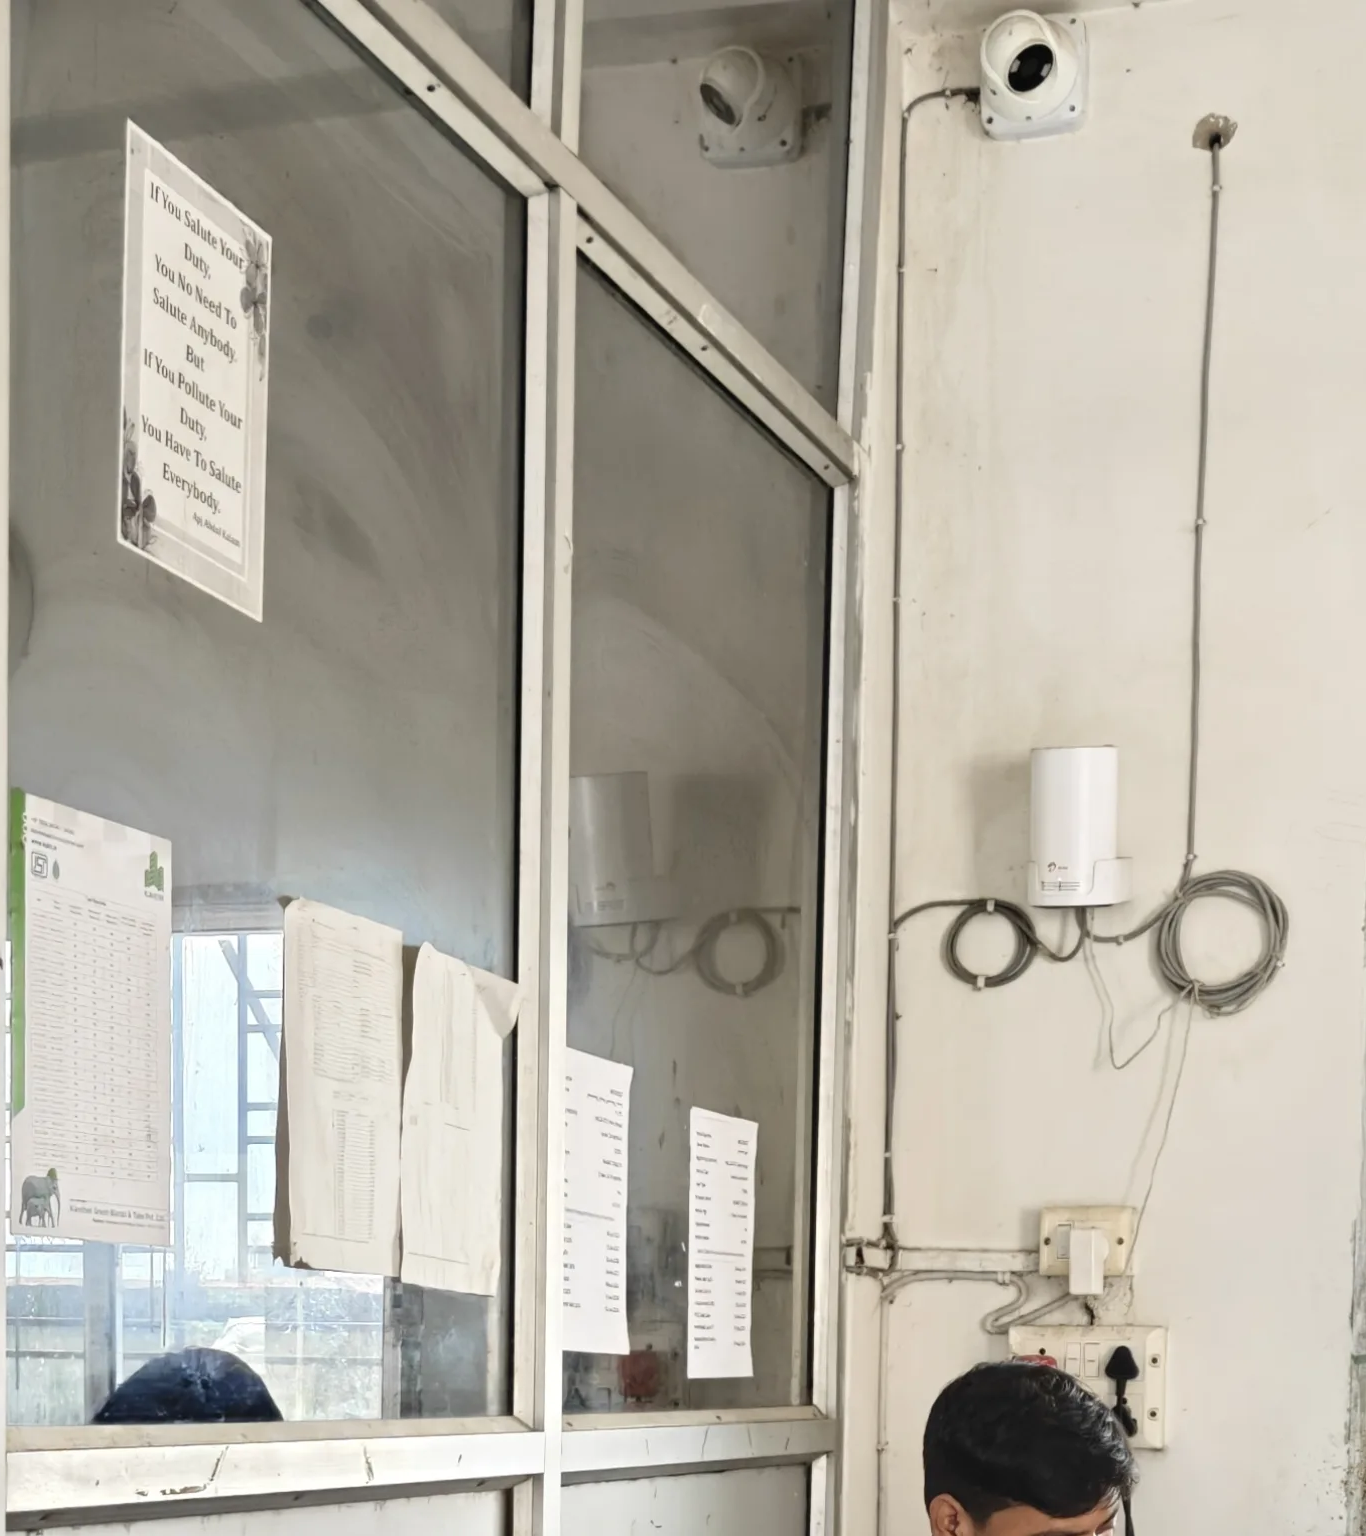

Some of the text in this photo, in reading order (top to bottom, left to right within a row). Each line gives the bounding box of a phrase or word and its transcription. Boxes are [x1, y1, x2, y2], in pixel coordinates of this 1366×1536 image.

[150, 182, 245, 269] If You Salute Your
[184, 243, 211, 280] Duty,
[153, 287, 237, 363] Salute Anybody.
[155, 254, 237, 329] You No Need To
[143, 348, 243, 430] If You Pollute Your
[186, 345, 205, 373] But
[141, 415, 242, 494] You Have To Salute
[180, 407, 207, 441] Duty,
[163, 462, 221, 515] Everybody.
